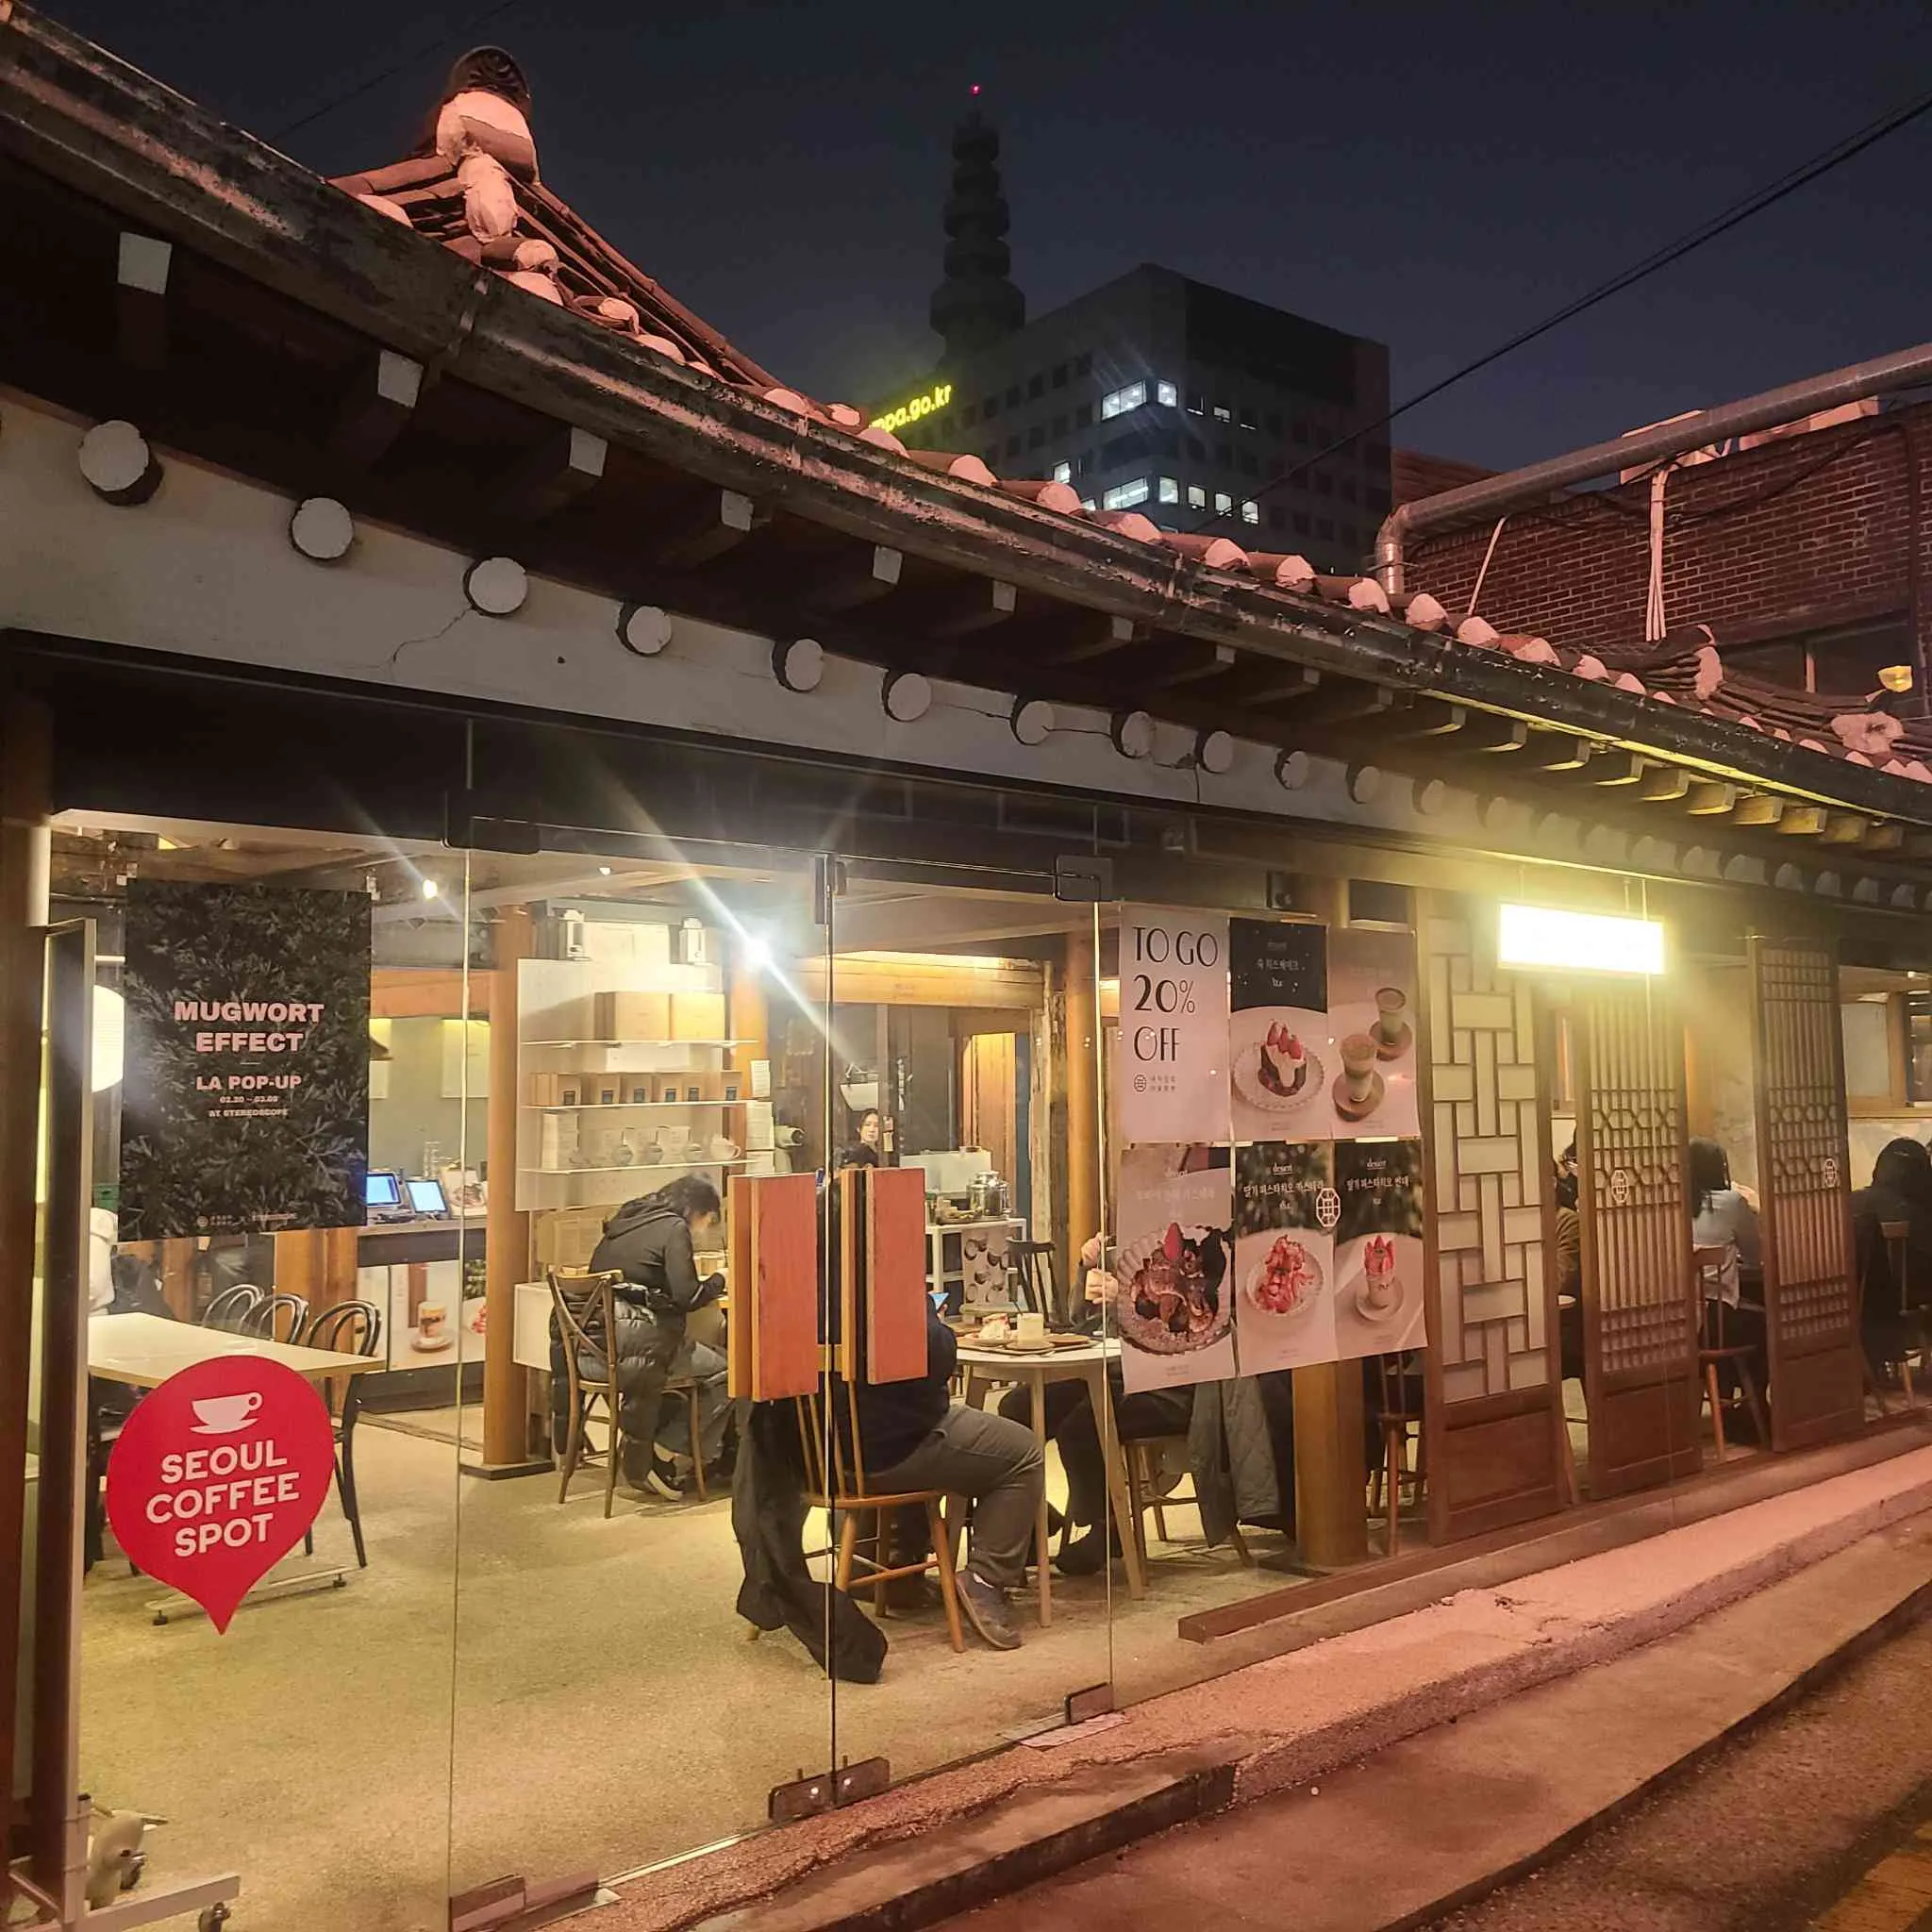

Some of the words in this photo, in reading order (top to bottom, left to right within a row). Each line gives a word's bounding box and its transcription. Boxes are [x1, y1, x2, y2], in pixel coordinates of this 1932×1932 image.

[1132, 927, 1170, 963] TO
[1175, 931, 1219, 967] GO
[174, 1001, 325, 1023] MUGWORT
[1134, 974, 1195, 1013] 20%
[196, 1032, 304, 1053] EFFECT
[1134, 1026, 1180, 1061] OFF
[195, 1075, 223, 1091] LA
[227, 1074, 302, 1090] POP-UP
[161, 1440, 287, 1483] SEOUL
[146, 1473, 300, 1524] COFFEE
[175, 1513, 274, 1557] SPOT
